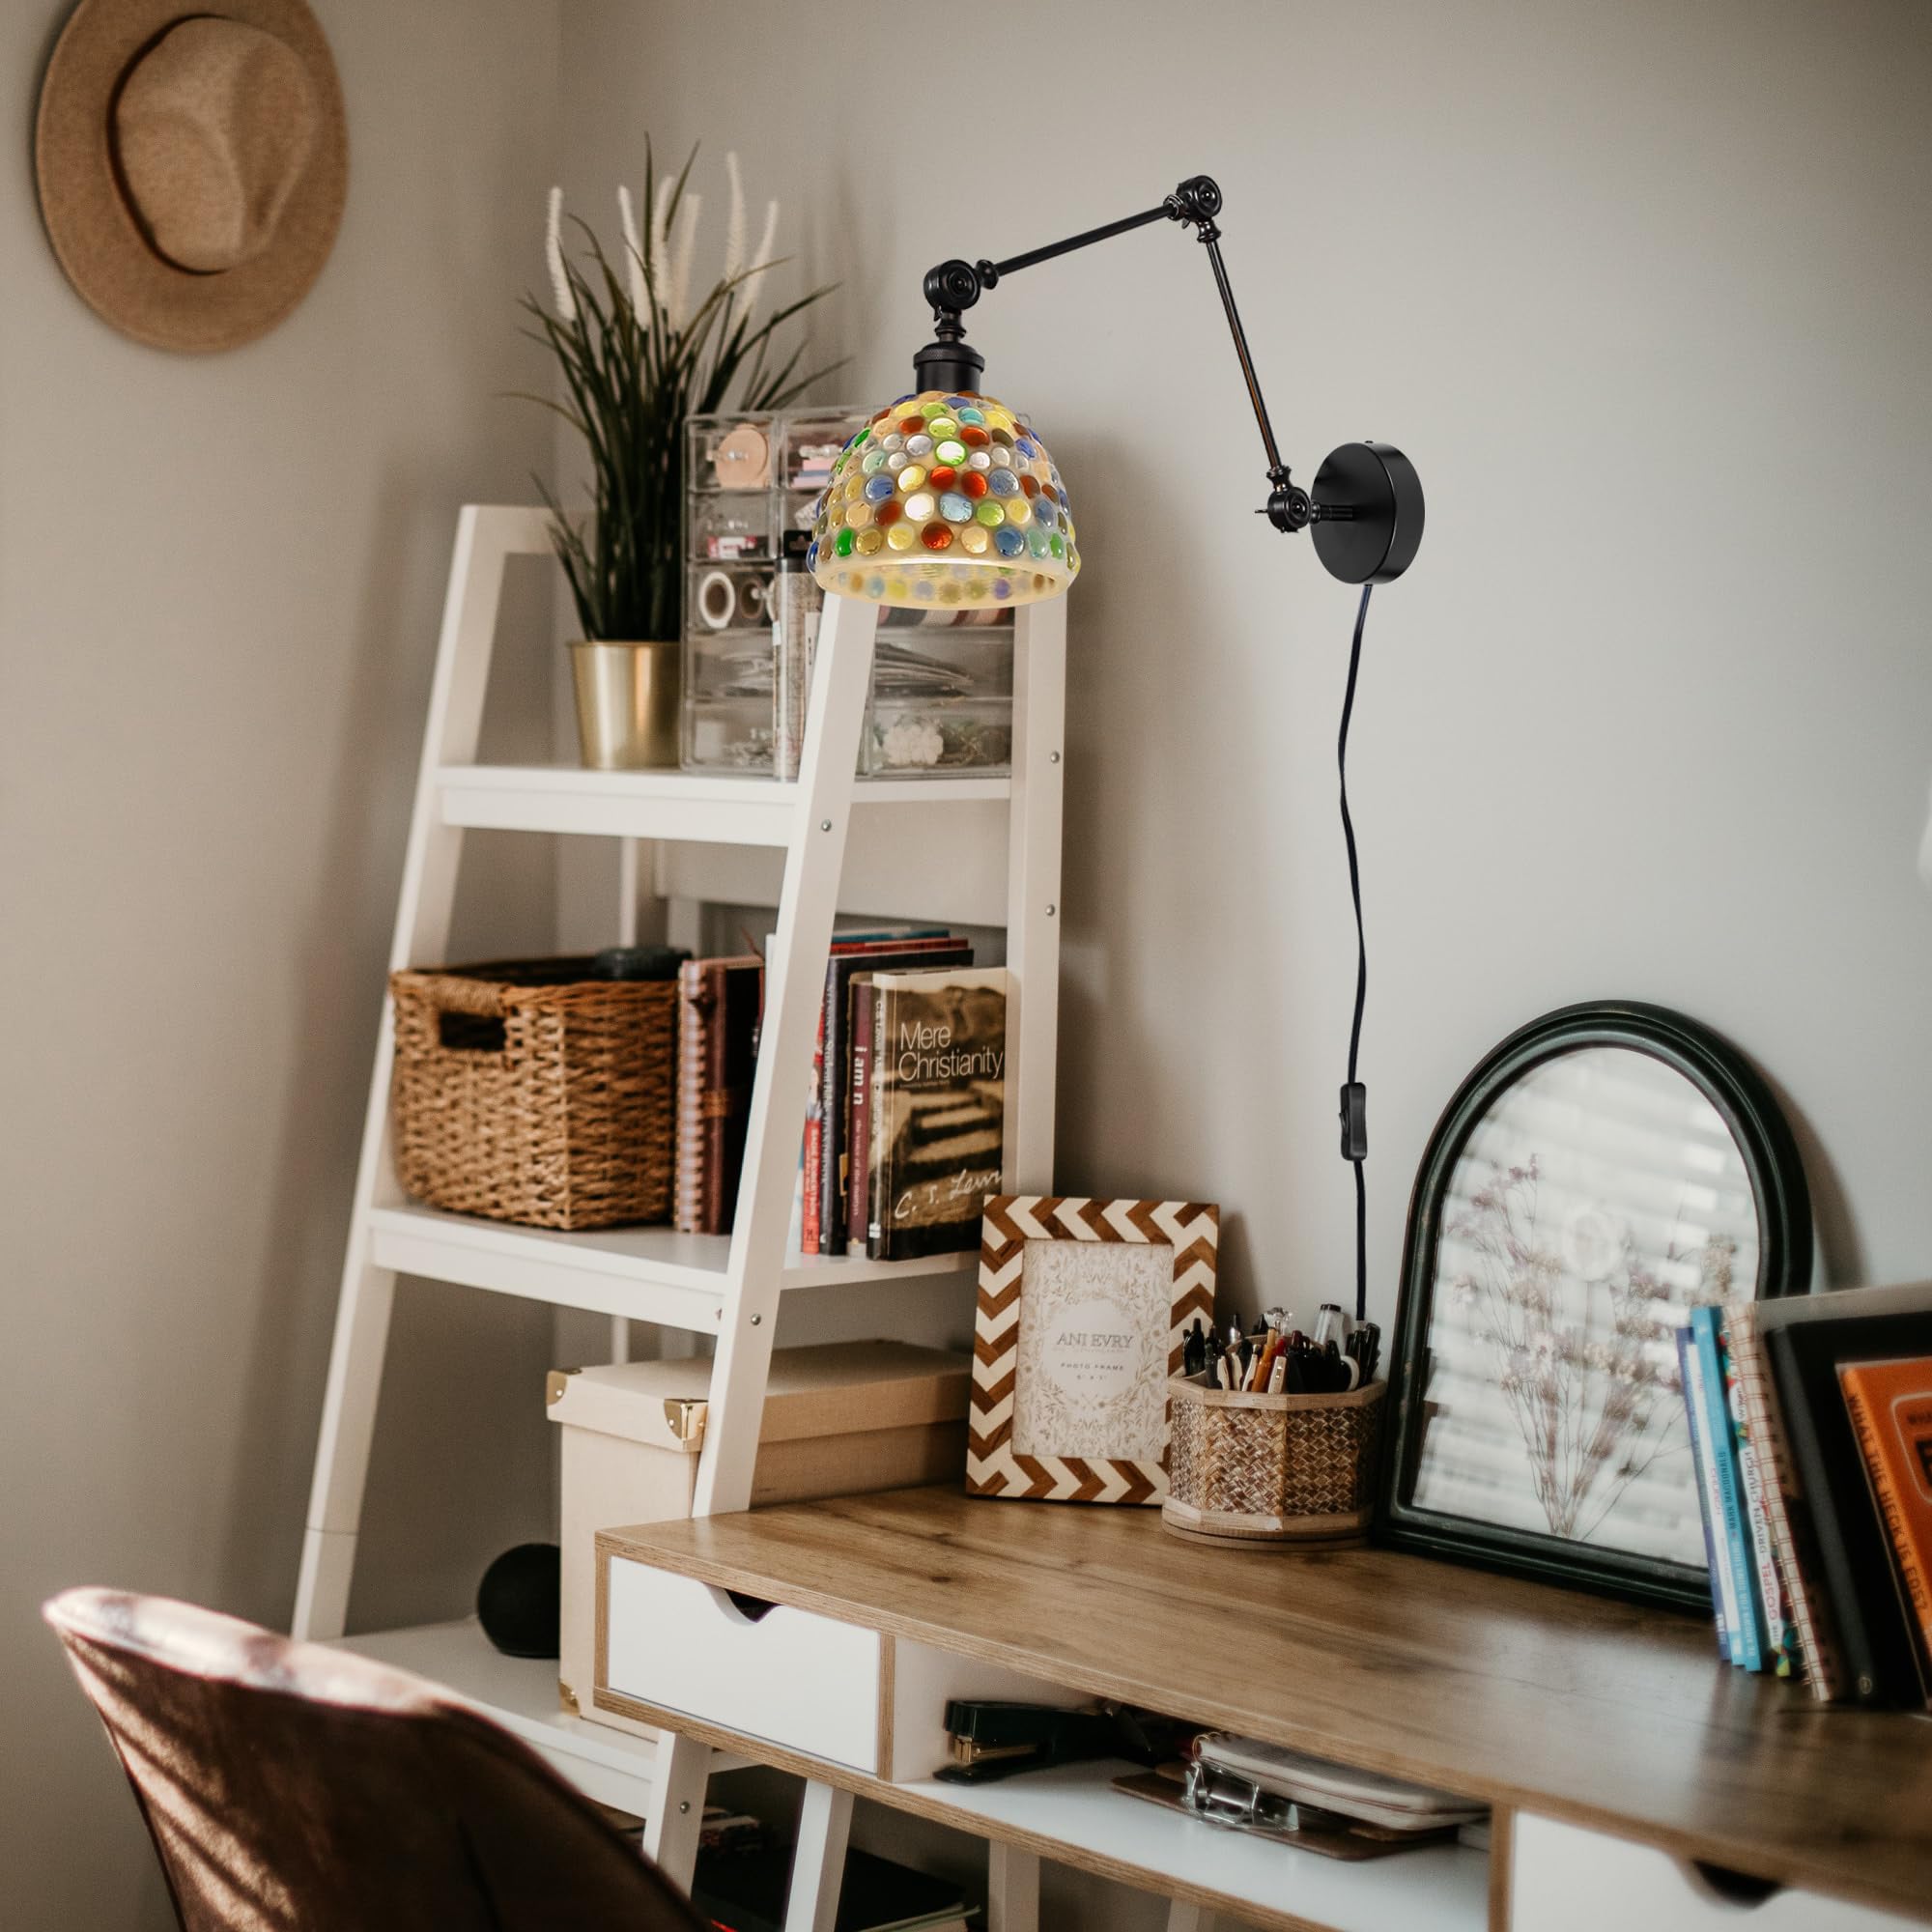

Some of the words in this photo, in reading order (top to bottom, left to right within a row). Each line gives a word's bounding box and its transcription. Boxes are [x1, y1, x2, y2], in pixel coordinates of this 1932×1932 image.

[900, 1021, 952, 1051] Mere
[853, 1058, 865, 1086] am
[898, 1046, 1004, 1082] Christianity
[853, 1093, 864, 1104] n
[894, 1190, 917, 1219] C.
[1847, 1394, 1872, 1443] WHAT
[1865, 1453, 1887, 1486] THE
[1745, 1451, 1760, 1504] CHURCH
[1727, 1504, 1739, 1530] MARK
